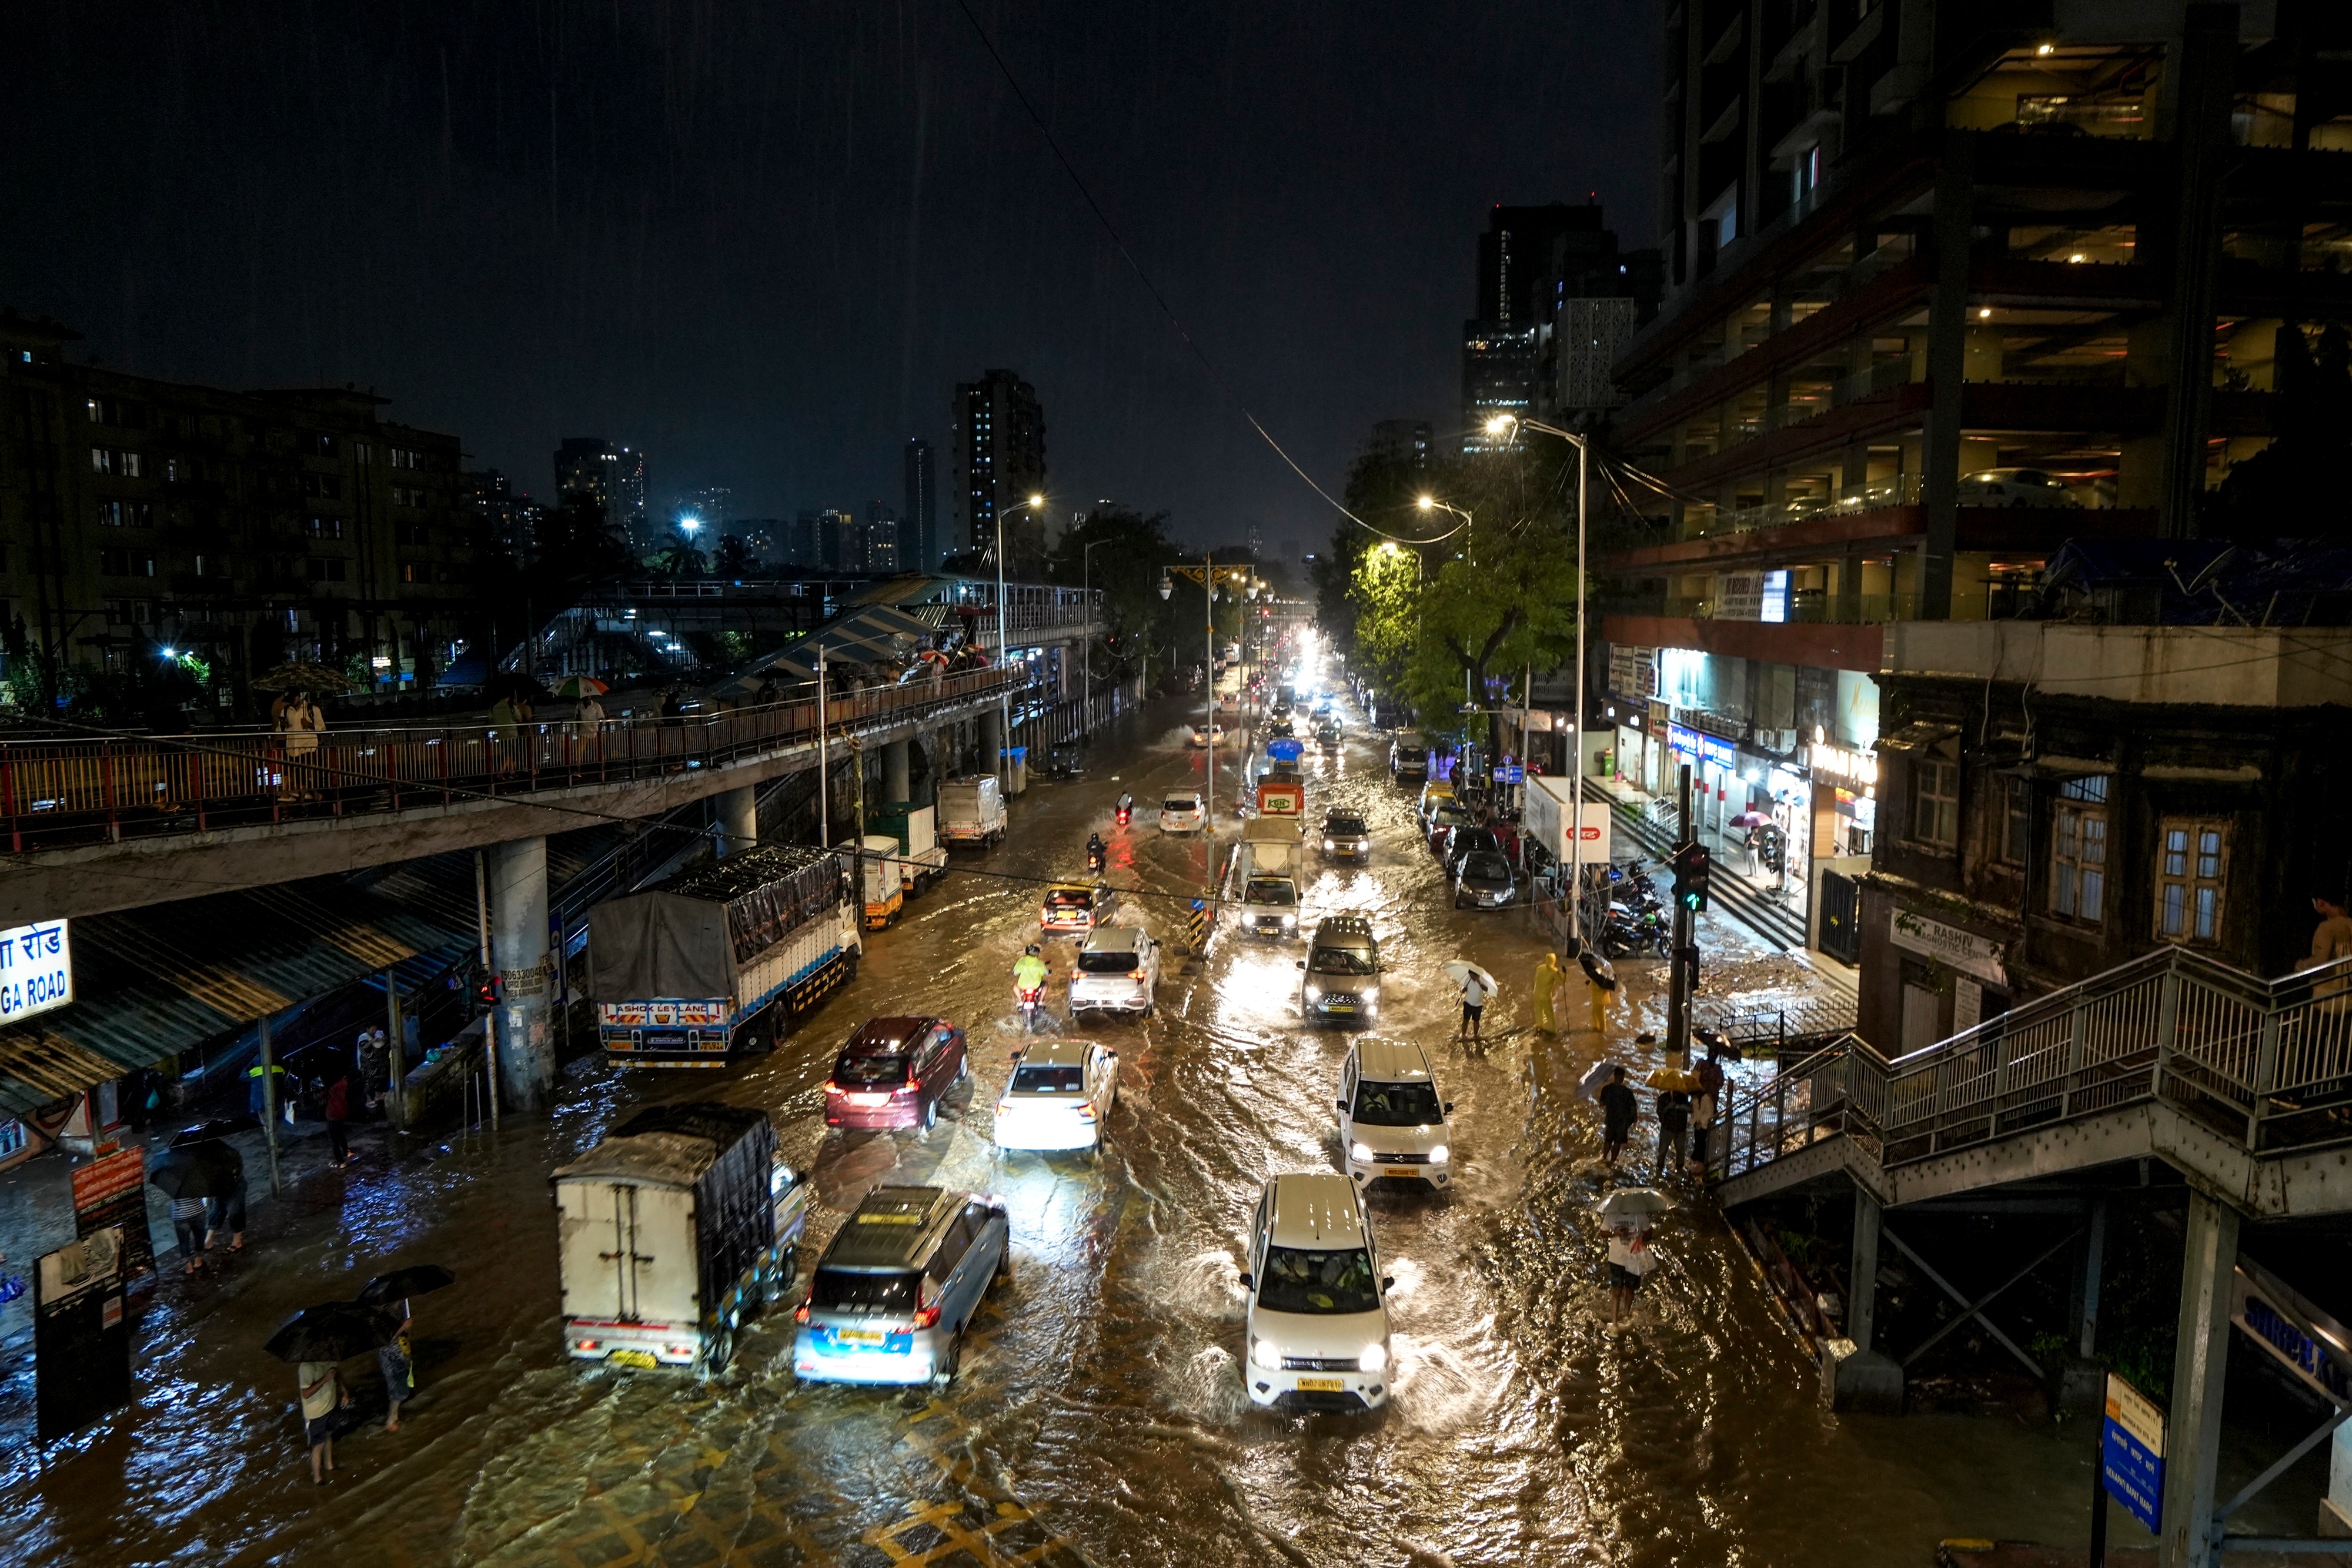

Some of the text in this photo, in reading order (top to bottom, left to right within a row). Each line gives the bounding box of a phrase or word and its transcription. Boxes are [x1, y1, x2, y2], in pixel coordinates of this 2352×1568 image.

[21, 924, 61, 960] रोड
[28, 970, 65, 1006] ROAD
[2106, 1465, 2126, 1490] SENAPATI
[2126, 1482, 2139, 1503] BAPAT
[2139, 1495, 2153, 1515] MARG
